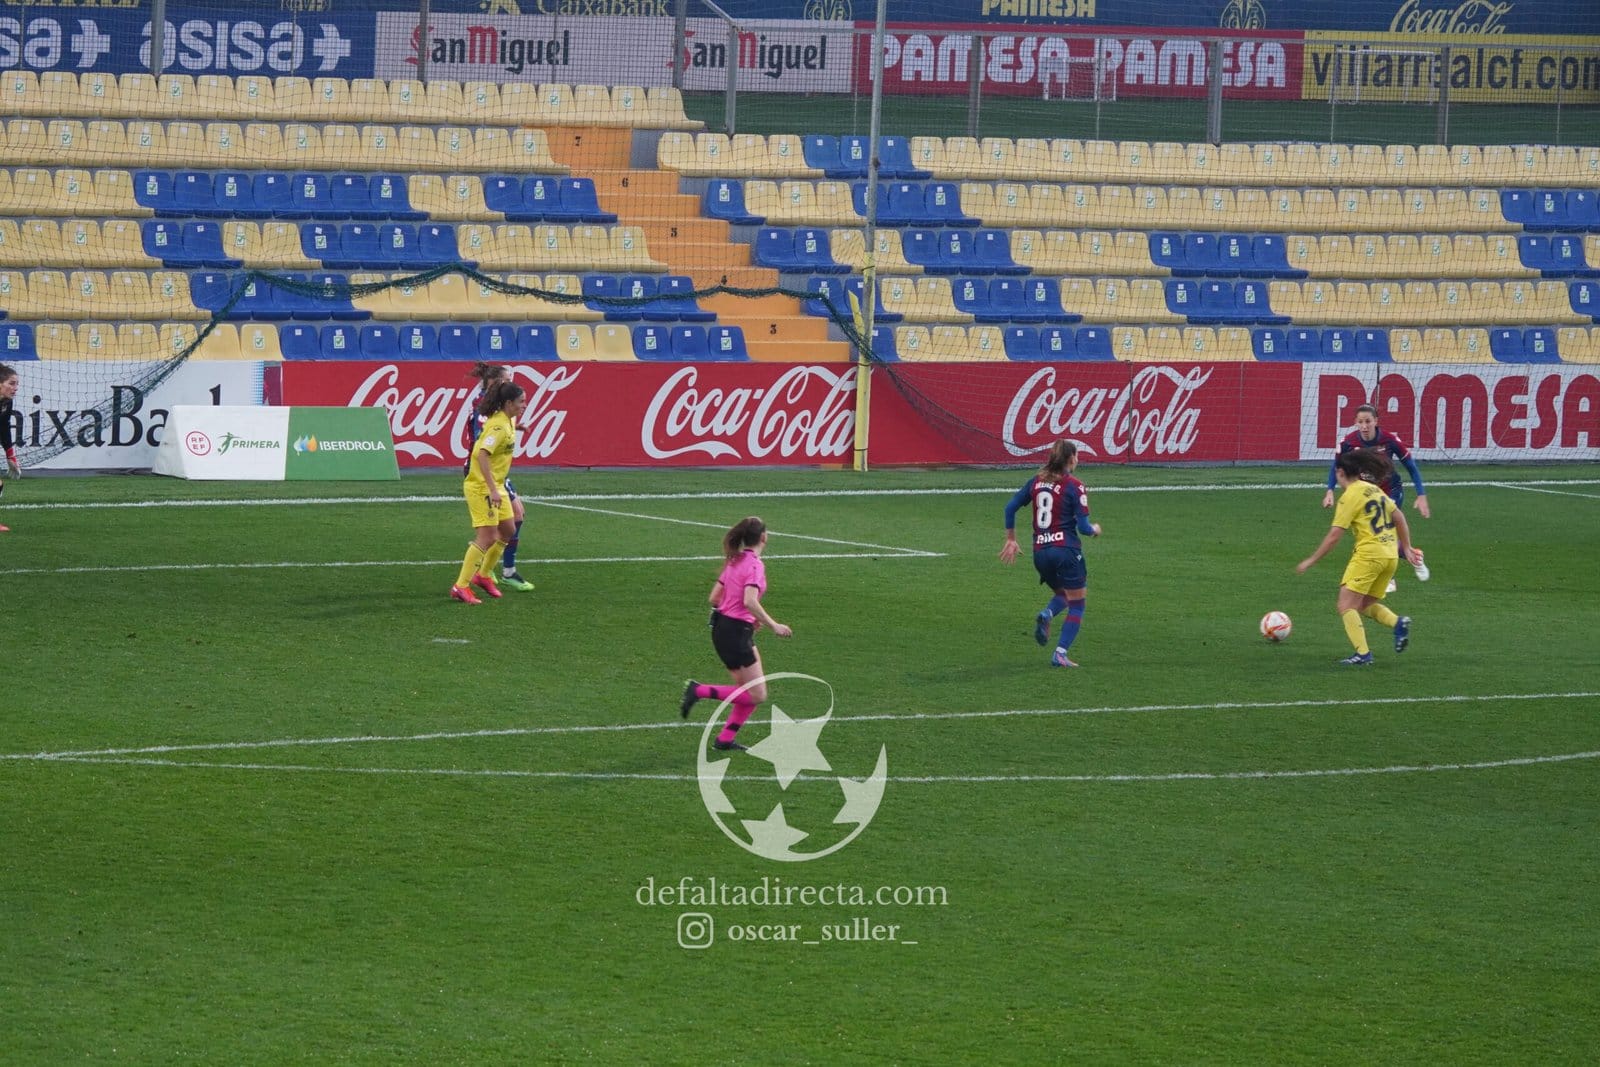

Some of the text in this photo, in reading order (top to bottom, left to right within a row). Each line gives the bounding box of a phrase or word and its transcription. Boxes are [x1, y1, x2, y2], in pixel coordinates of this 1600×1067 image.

[139, 20, 304, 71] asisa
[869, 34, 1070, 83] PAMESA
[349, 365, 582, 460] Coca-Cla
[641, 366, 874, 459] Coca-Cola
[1002, 366, 1214, 457] Coca-Cola
[1316, 373, 1600, 449] PAMESA
[232, 440, 280, 448] PRIMERA
[319, 440, 387, 451] IBERDROLA
[1036, 490, 1054, 529] 8
